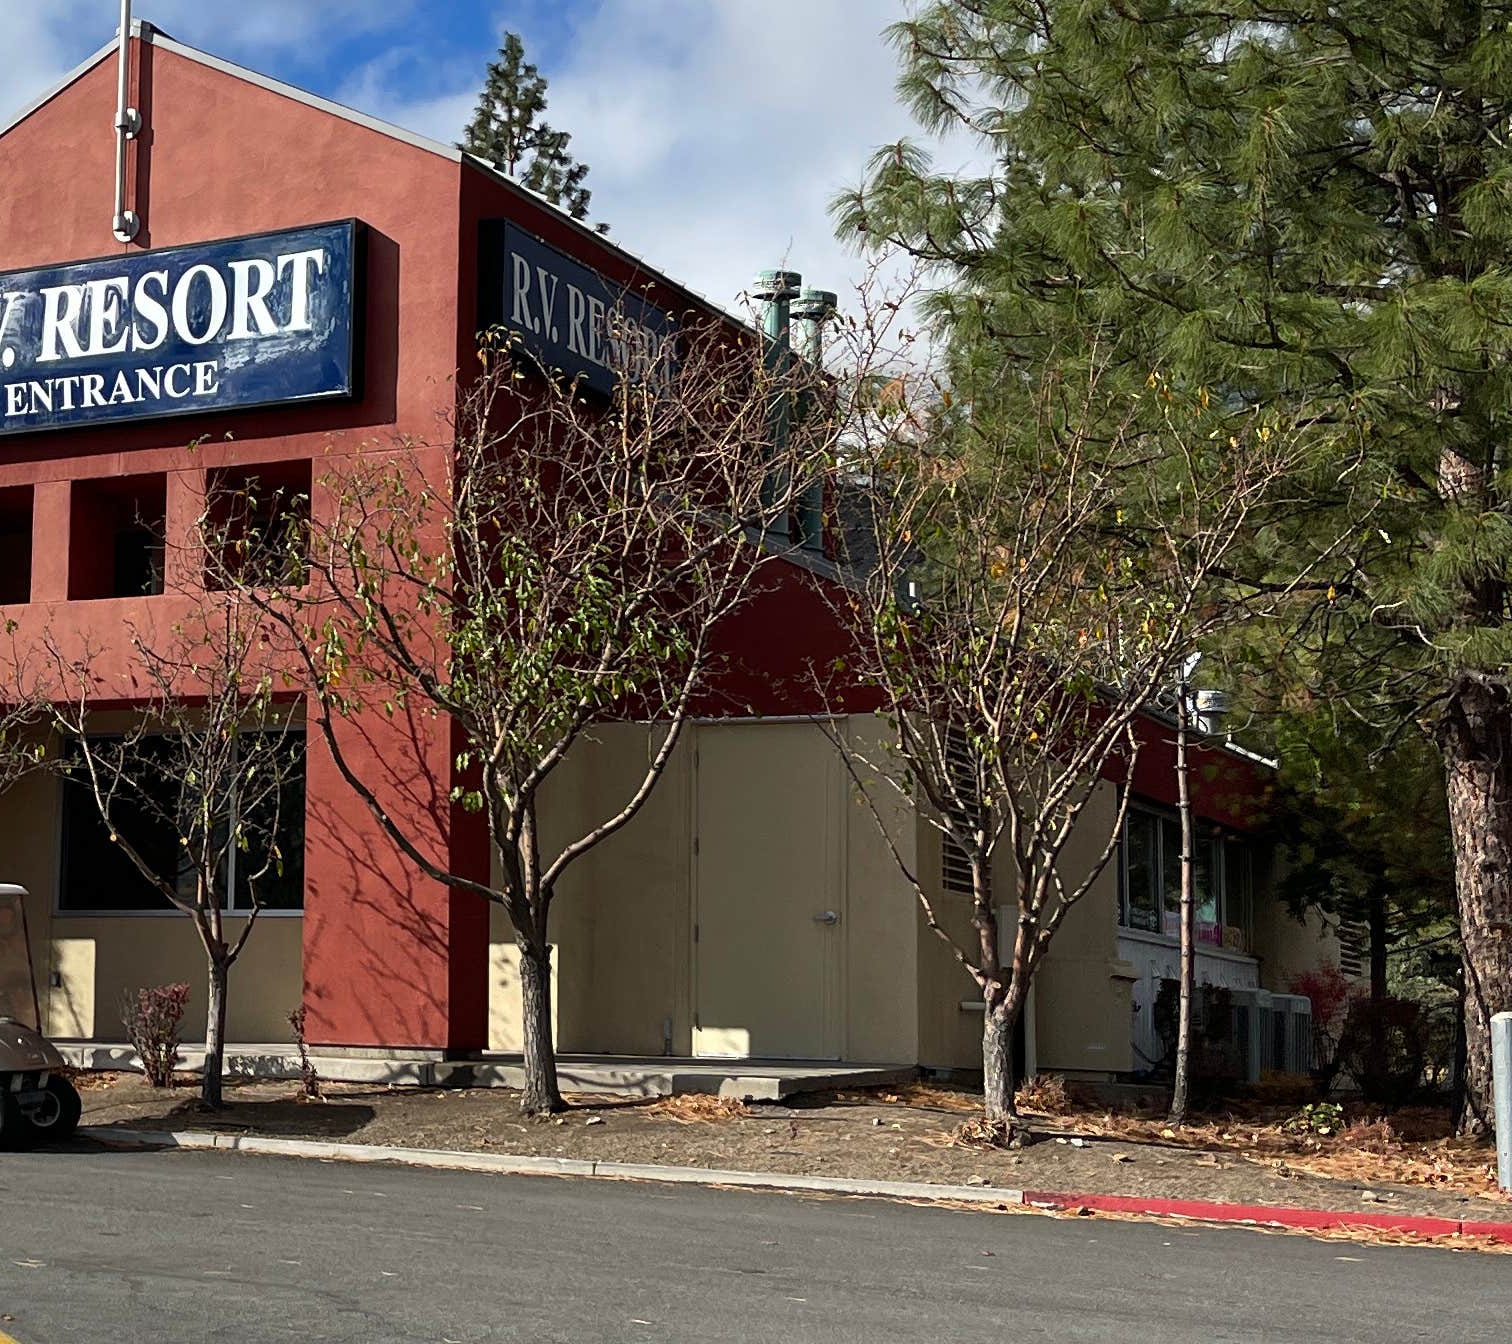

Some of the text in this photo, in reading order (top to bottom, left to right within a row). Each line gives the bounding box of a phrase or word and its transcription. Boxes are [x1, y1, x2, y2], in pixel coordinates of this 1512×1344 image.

[35, 248, 325, 364] RESORT
[510, 252, 559, 344] R.V.
[4, 360, 220, 417] ENTRANCE
